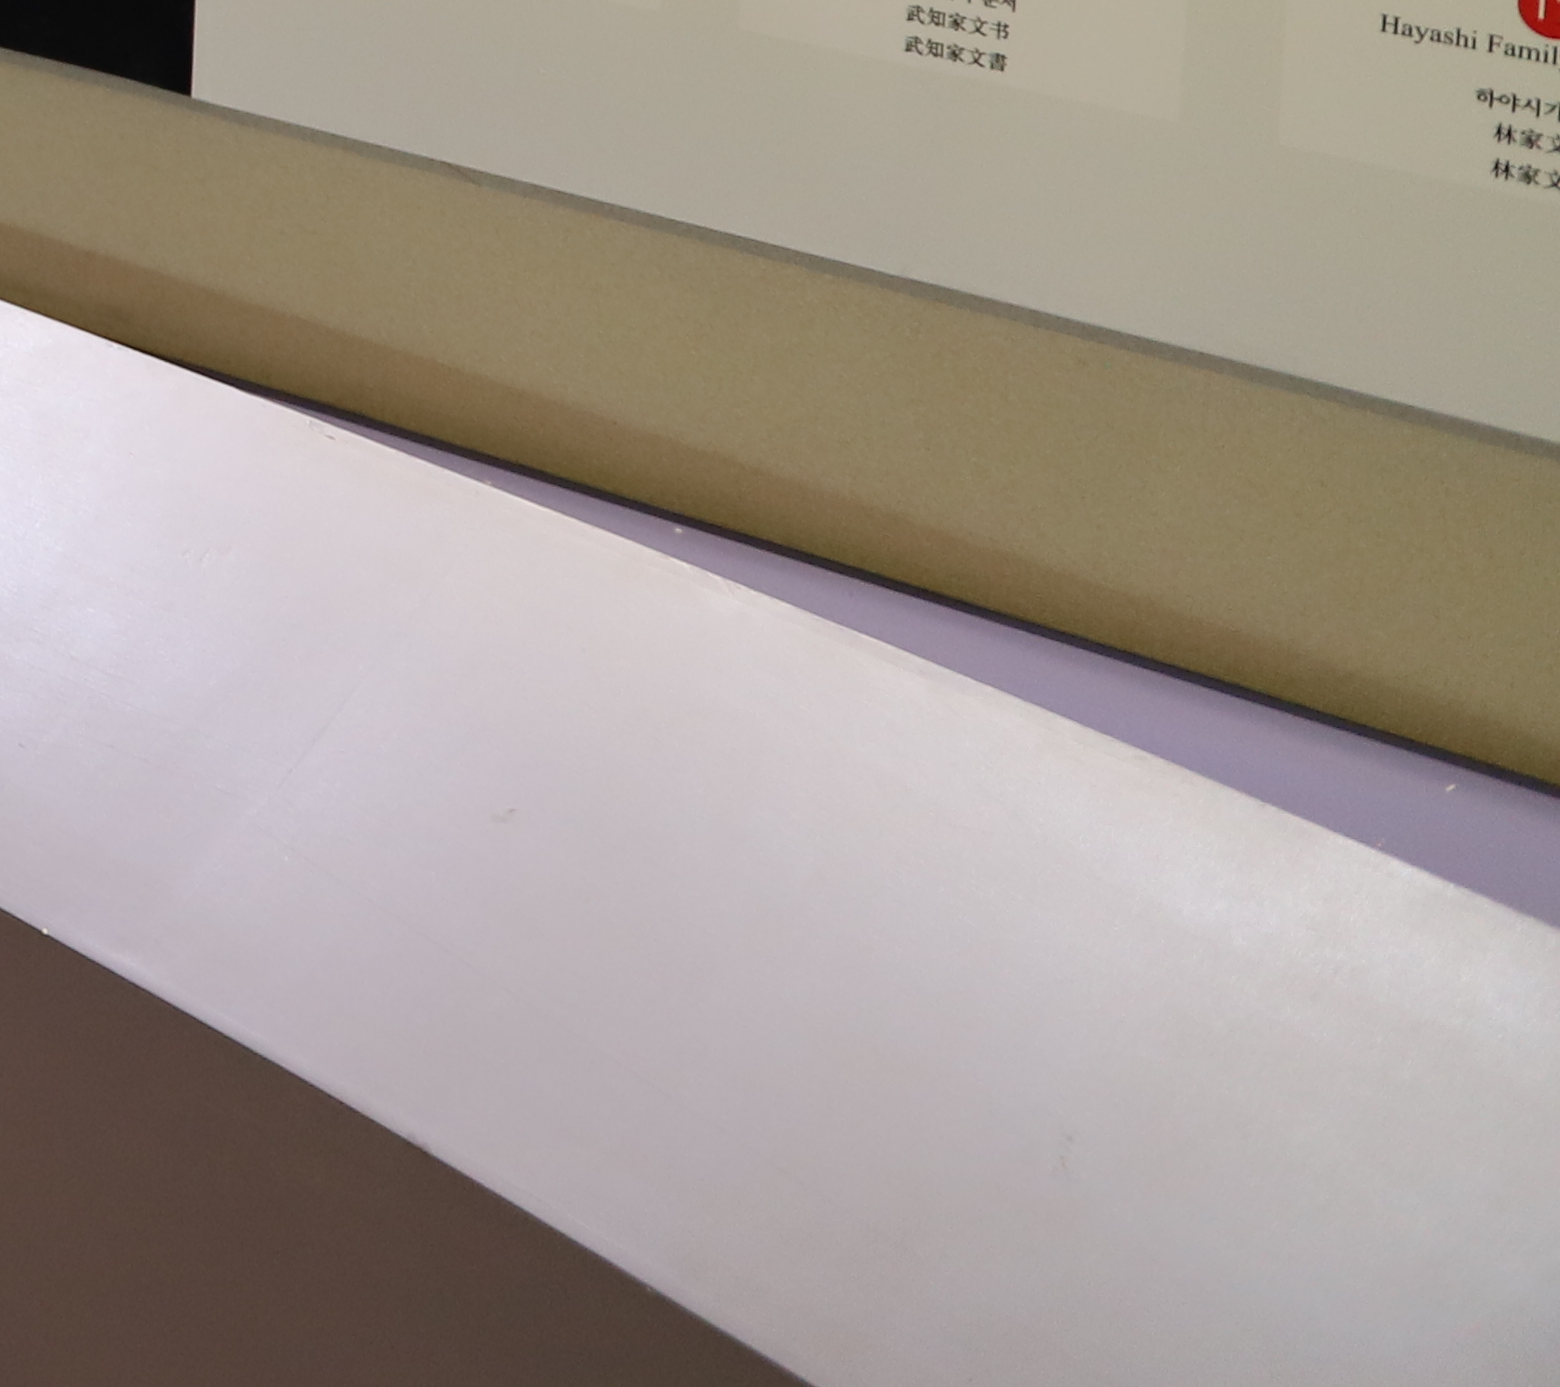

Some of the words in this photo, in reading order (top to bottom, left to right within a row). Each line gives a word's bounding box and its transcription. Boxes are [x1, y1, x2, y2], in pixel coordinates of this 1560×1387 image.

[905, 5, 1010, 40] 武知家文书
[1380, 12, 1478, 51] Hayashi
[904, 36, 1008, 73] 武知家文書
